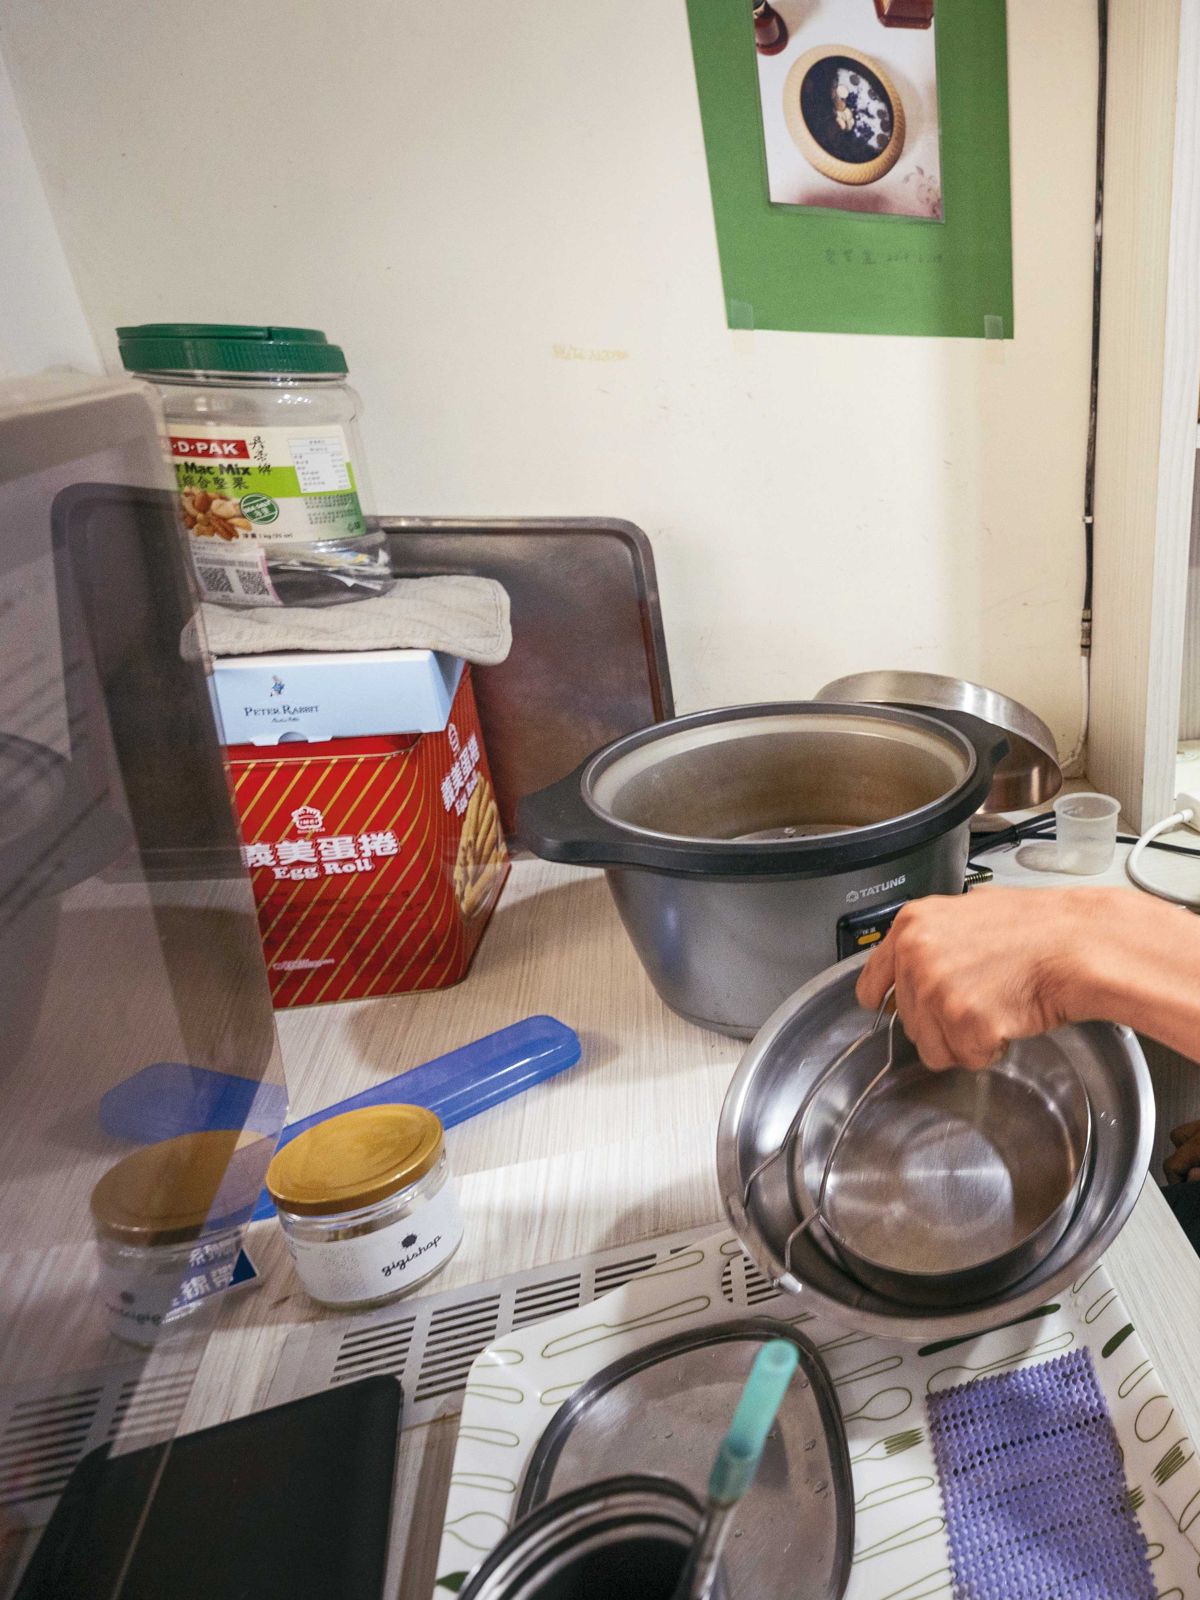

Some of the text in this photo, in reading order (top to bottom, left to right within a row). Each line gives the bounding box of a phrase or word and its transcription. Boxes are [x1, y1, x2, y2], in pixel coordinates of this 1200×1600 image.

[172, 441, 239, 456] ·D·PAK
[184, 461, 215, 476] Mac
[219, 463, 250, 476] Mix
[243, 706, 279, 717] PETER
[272, 858, 374, 881] Egg Roll
[860, 875, 906, 898] TATUNG
